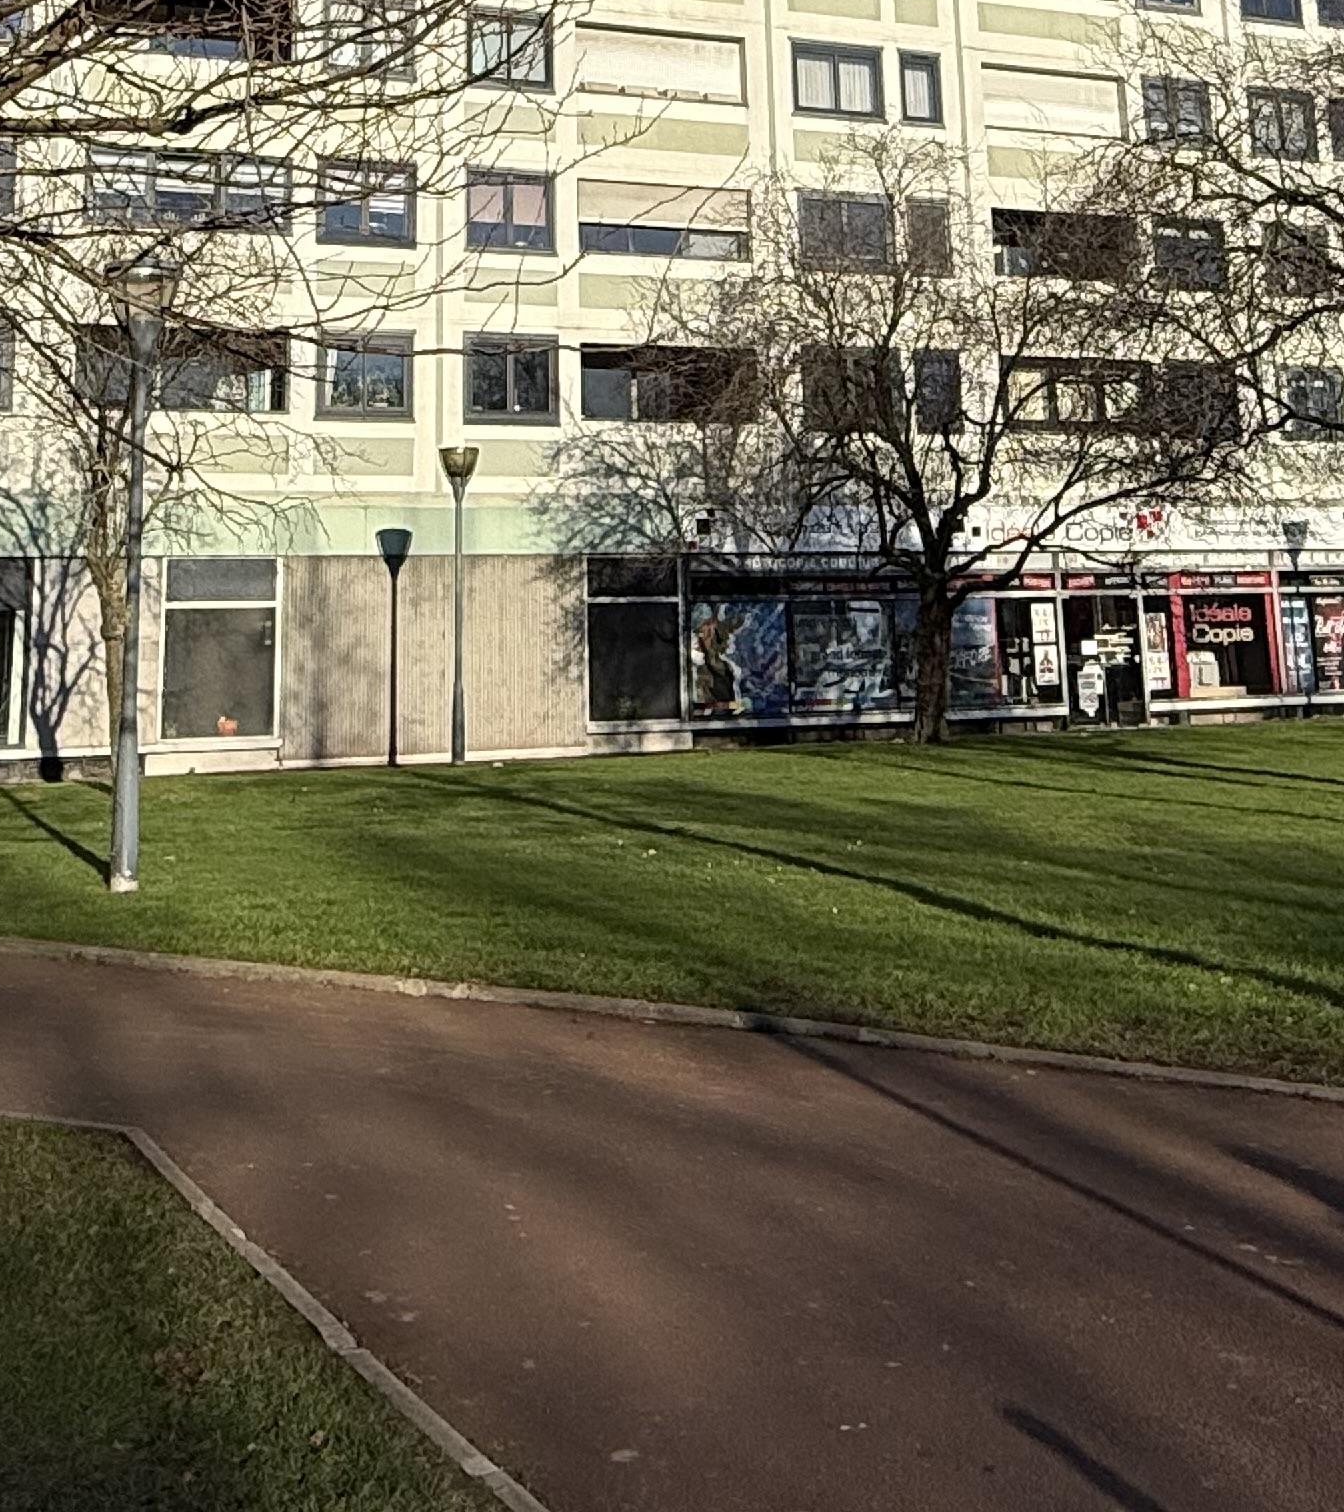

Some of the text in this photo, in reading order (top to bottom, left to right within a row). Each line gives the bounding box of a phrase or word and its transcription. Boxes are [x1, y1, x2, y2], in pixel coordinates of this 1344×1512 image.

[985, 518, 1133, 545] Idée Copie
[1189, 602, 1252, 622] Idéale
[1192, 623, 1254, 646] Copie
